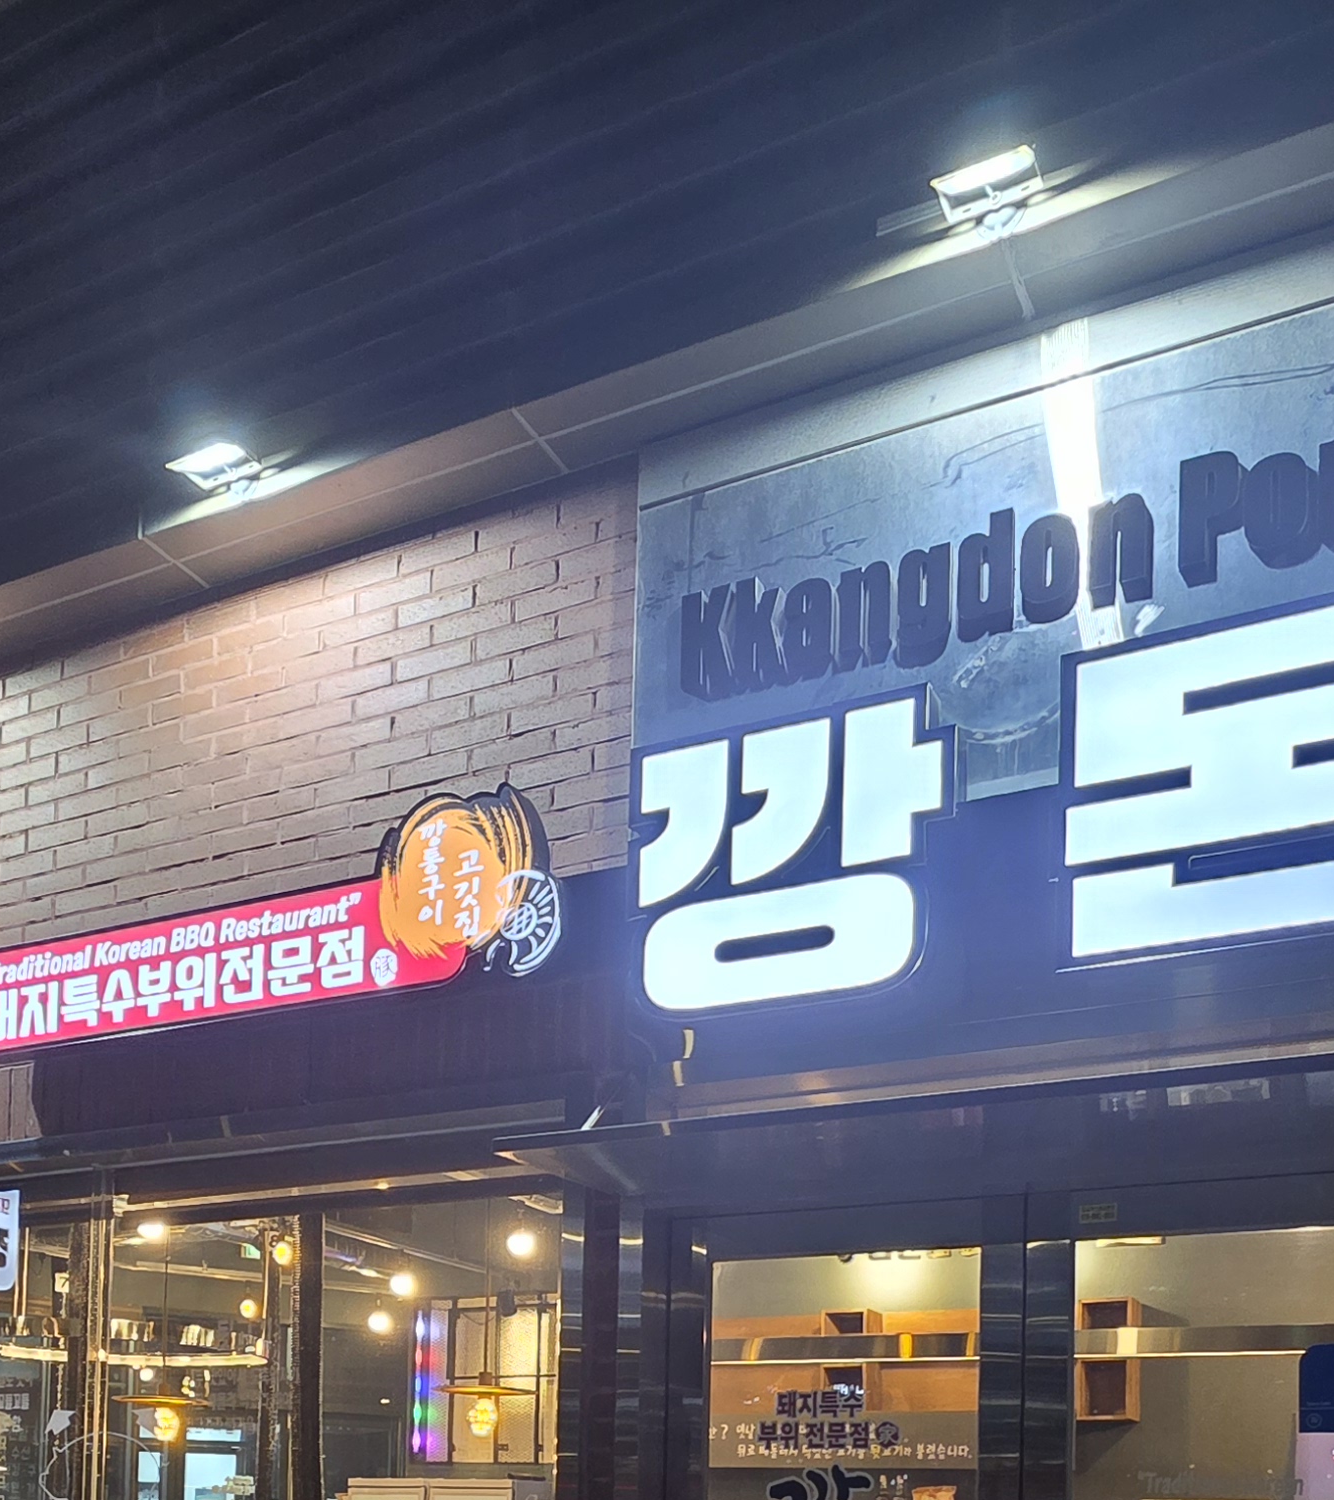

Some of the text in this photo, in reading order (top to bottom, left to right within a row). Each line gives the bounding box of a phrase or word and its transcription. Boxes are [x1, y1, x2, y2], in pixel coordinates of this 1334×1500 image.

[680, 490, 1154, 702] Kkangdon
[417, 818, 448, 926] 깡통구이
[452, 848, 485, 938] 고깃집
[93, 933, 167, 967] Korean
[169, 925, 216, 955] BBQ
[756, 1420, 870, 1451] 부위전문점
[775, 1389, 864, 1420] 돼지특수
